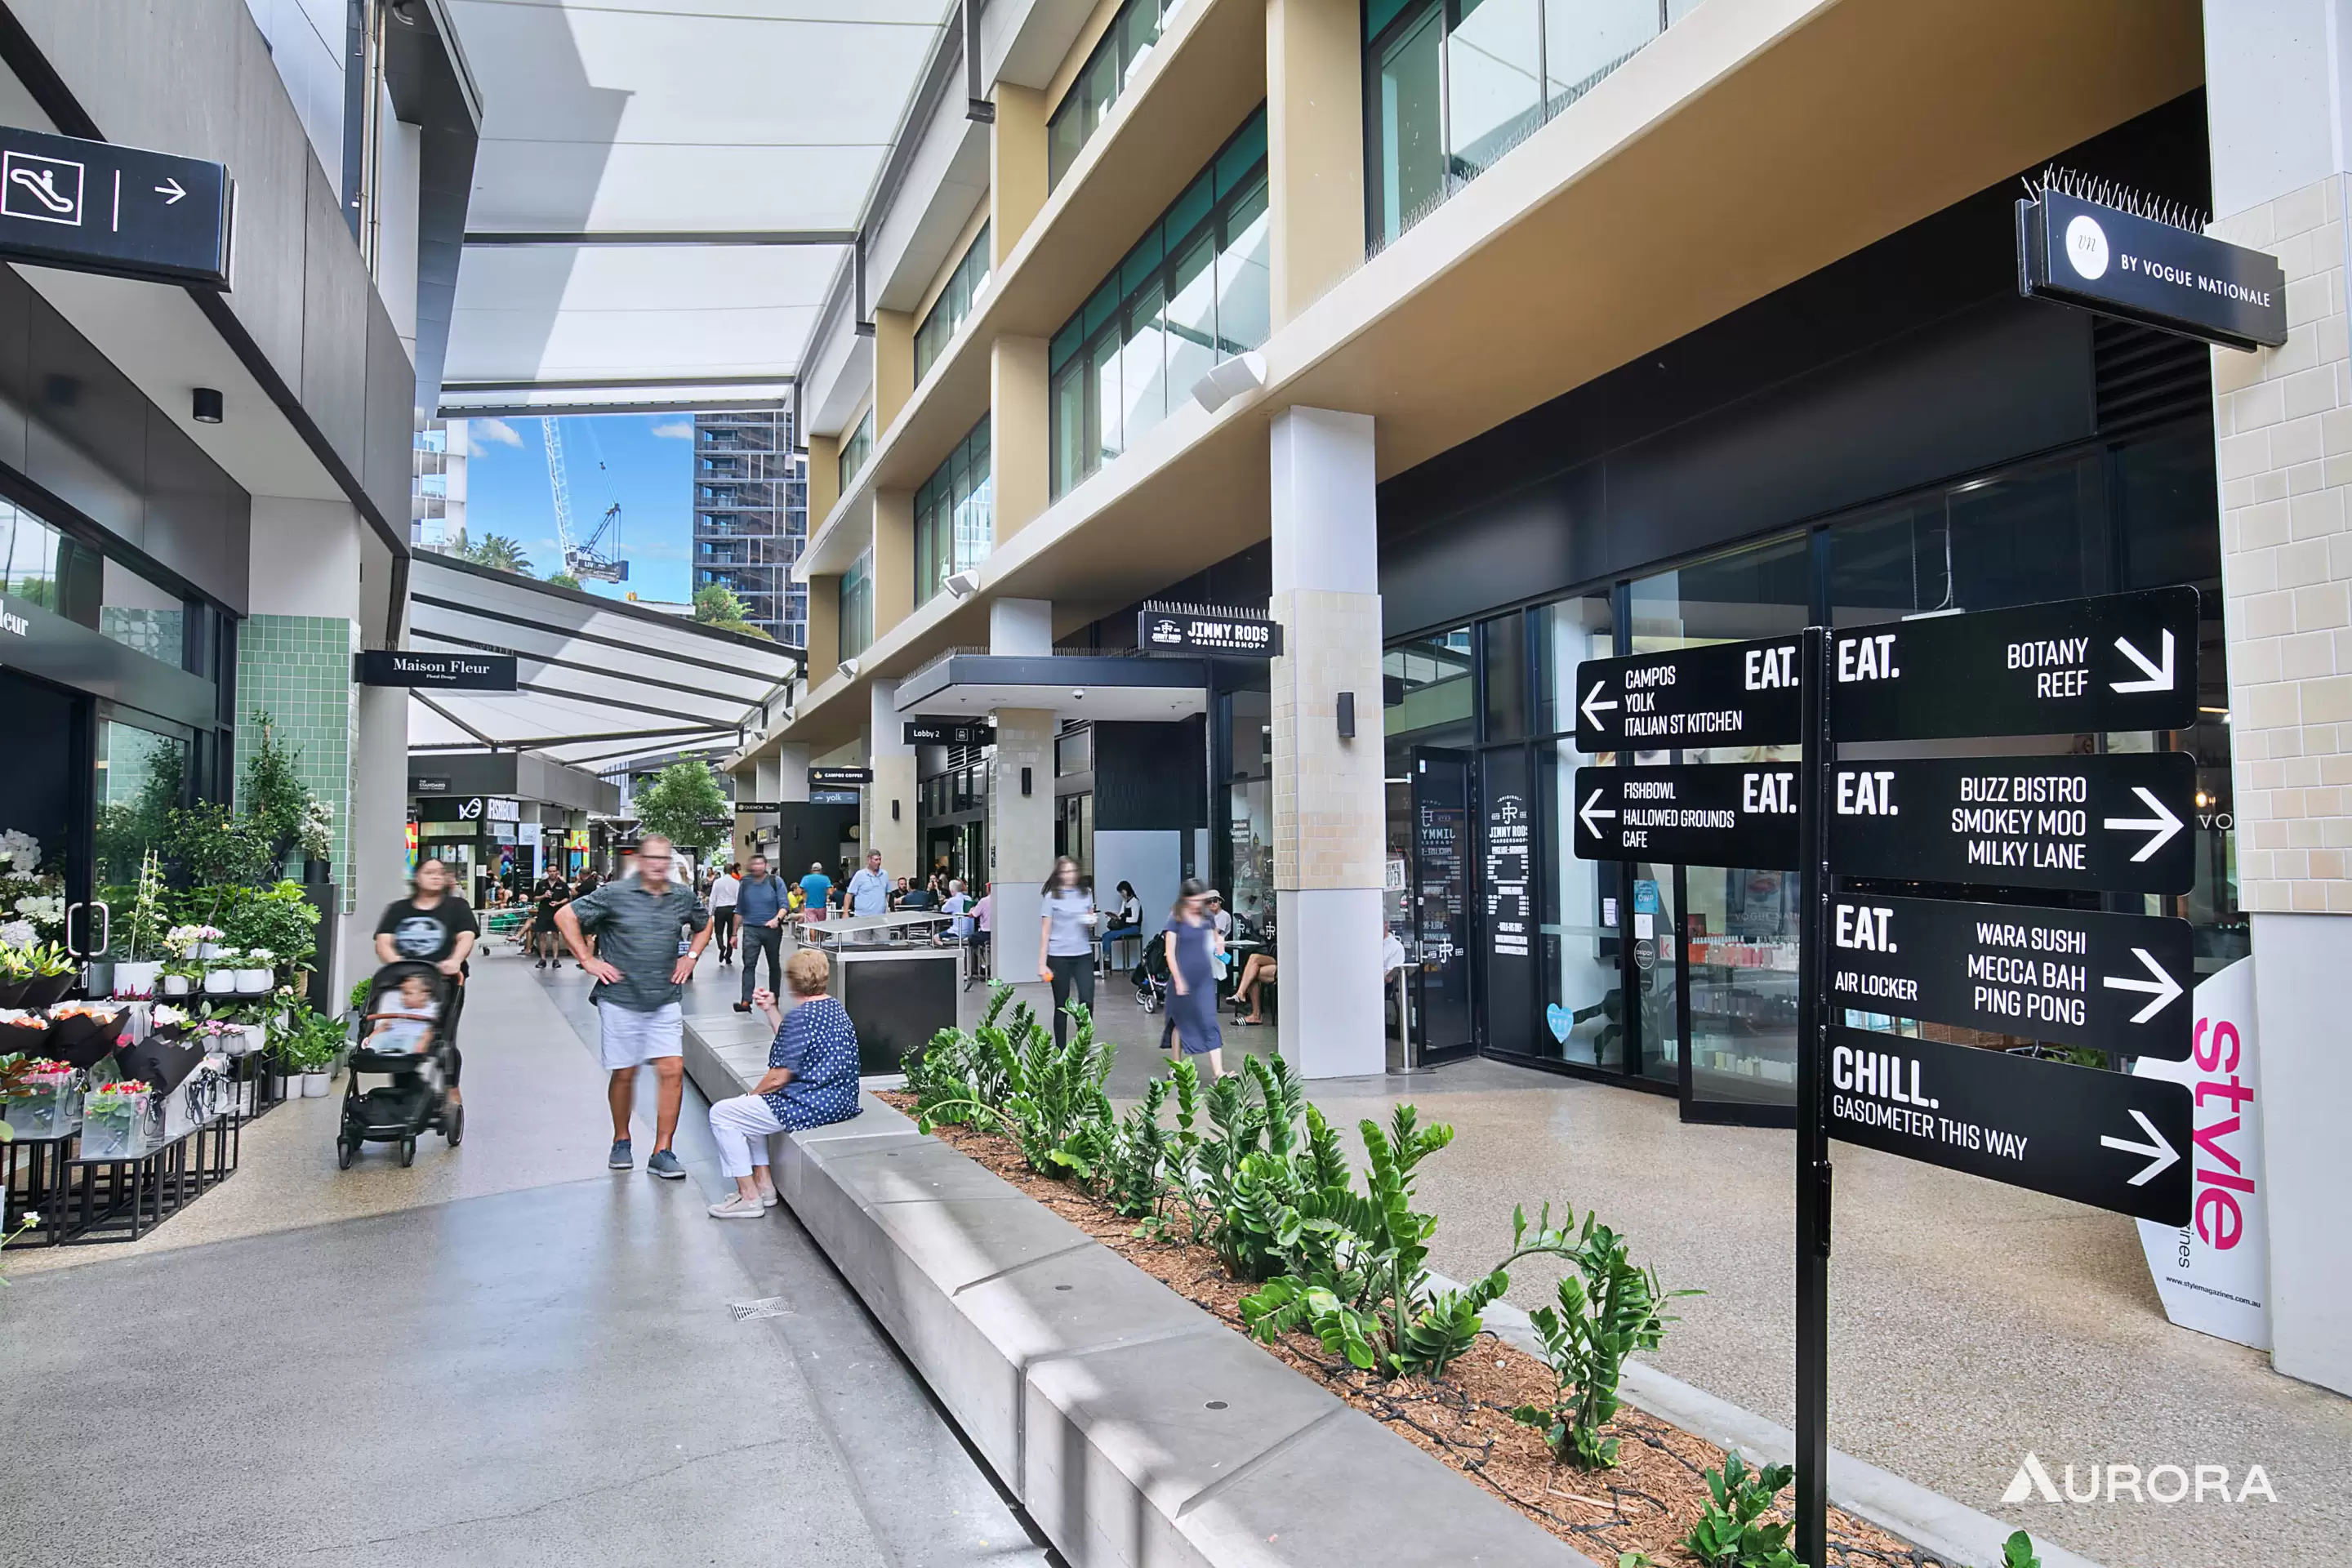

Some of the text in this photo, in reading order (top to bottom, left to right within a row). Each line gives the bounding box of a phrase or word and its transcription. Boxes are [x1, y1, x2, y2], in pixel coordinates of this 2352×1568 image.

[2121, 254, 2270, 307] BY VOGUE NATIONALE
[1187, 621, 1269, 642] JIMMY RODS
[1196, 639, 1261, 648] BARBERSHOP
[393, 657, 490, 675] Maison Fleur
[1838, 635, 1900, 682] EAT.
[2007, 637, 2089, 669] BOTANY
[1625, 666, 1676, 689] CAMPOS
[1745, 646, 1799, 691] EAT.
[2038, 670, 2089, 698] REEF
[1625, 692, 1655, 713] YOLK
[913, 729, 934, 738] Lobby
[1624, 710, 1742, 737] ITALIAN ST KITCHEN
[826, 794, 842, 804] yolk
[1624, 782, 1676, 800] FISHBOWL
[1743, 773, 1797, 814] EAT.
[1837, 771, 1899, 815] EAT.
[1960, 777, 2087, 803] BUZZ BISTRO
[1489, 826, 1511, 838] JIMMY
[1624, 809, 1735, 828] HALLOWED GROUNDS
[1952, 808, 2086, 836] SMOKEY MOO
[1623, 831, 1648, 848] CAFE
[1968, 840, 2087, 870] MILKY LANE
[1836, 904, 1898, 953] EAT.
[1976, 922, 2086, 955] WARA SUSHI
[1835, 970, 1918, 1001] AIR LOCKER
[1967, 954, 2086, 992] MECCA BAH
[1974, 987, 2086, 1026] PING PONG
[1833, 1045, 1939, 1109] CHILL.
[1833, 1094, 2028, 1160] GASOMETER THIS WAY
[2193, 1017, 2255, 1250] style
[2166, 1276, 2261, 1308] www.stylemagazines.com.au
